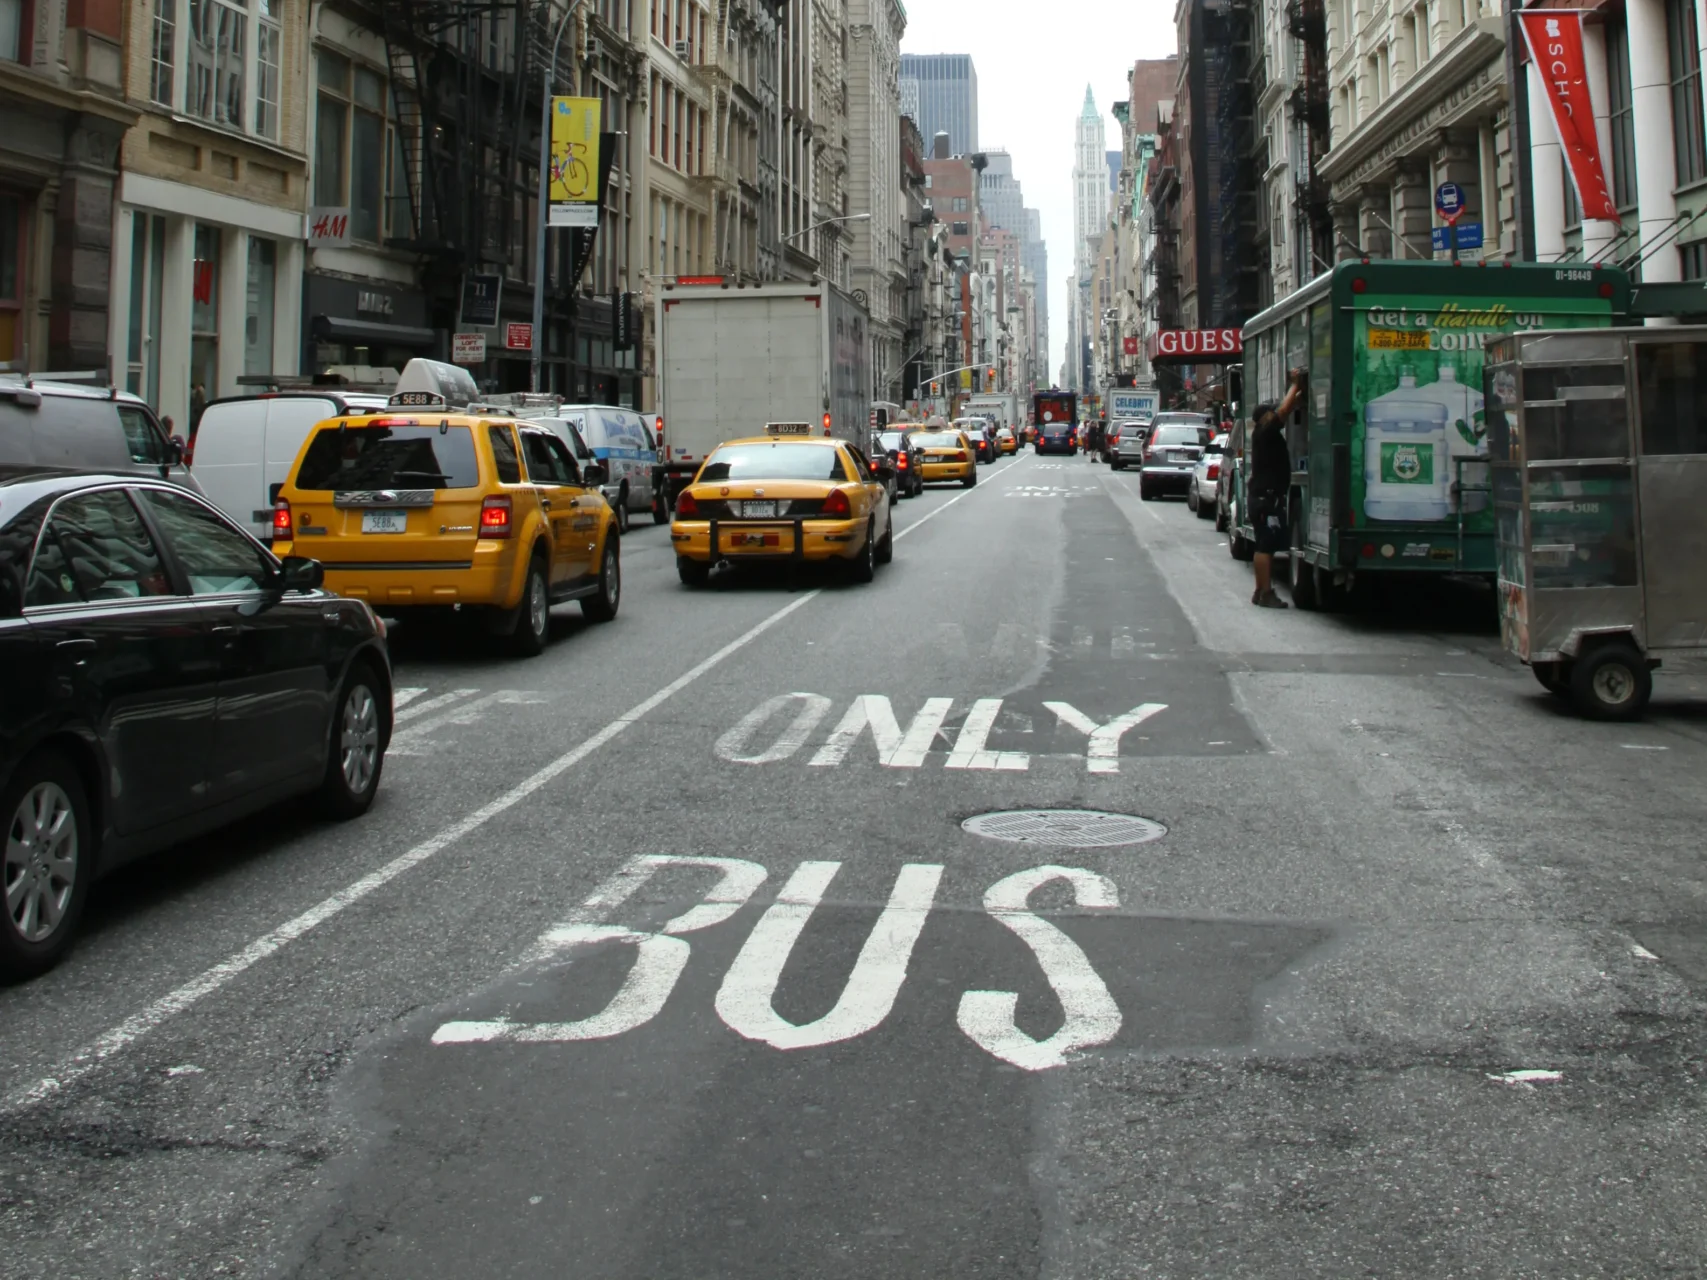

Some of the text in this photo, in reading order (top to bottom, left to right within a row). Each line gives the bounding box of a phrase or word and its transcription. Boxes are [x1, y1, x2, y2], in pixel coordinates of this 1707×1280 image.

[312, 214, 348, 239] H&M
[1367, 305, 1408, 326] Get
[1415, 312, 1428, 326] a
[1515, 313, 1543, 326] on
[403, 394, 427, 405] 5E88
[1115, 397, 1153, 409] CELEBRITY
[777, 424, 798, 433] 8D32
[713, 692, 1169, 773] ONLY
[431, 854, 1123, 1072] BUS
